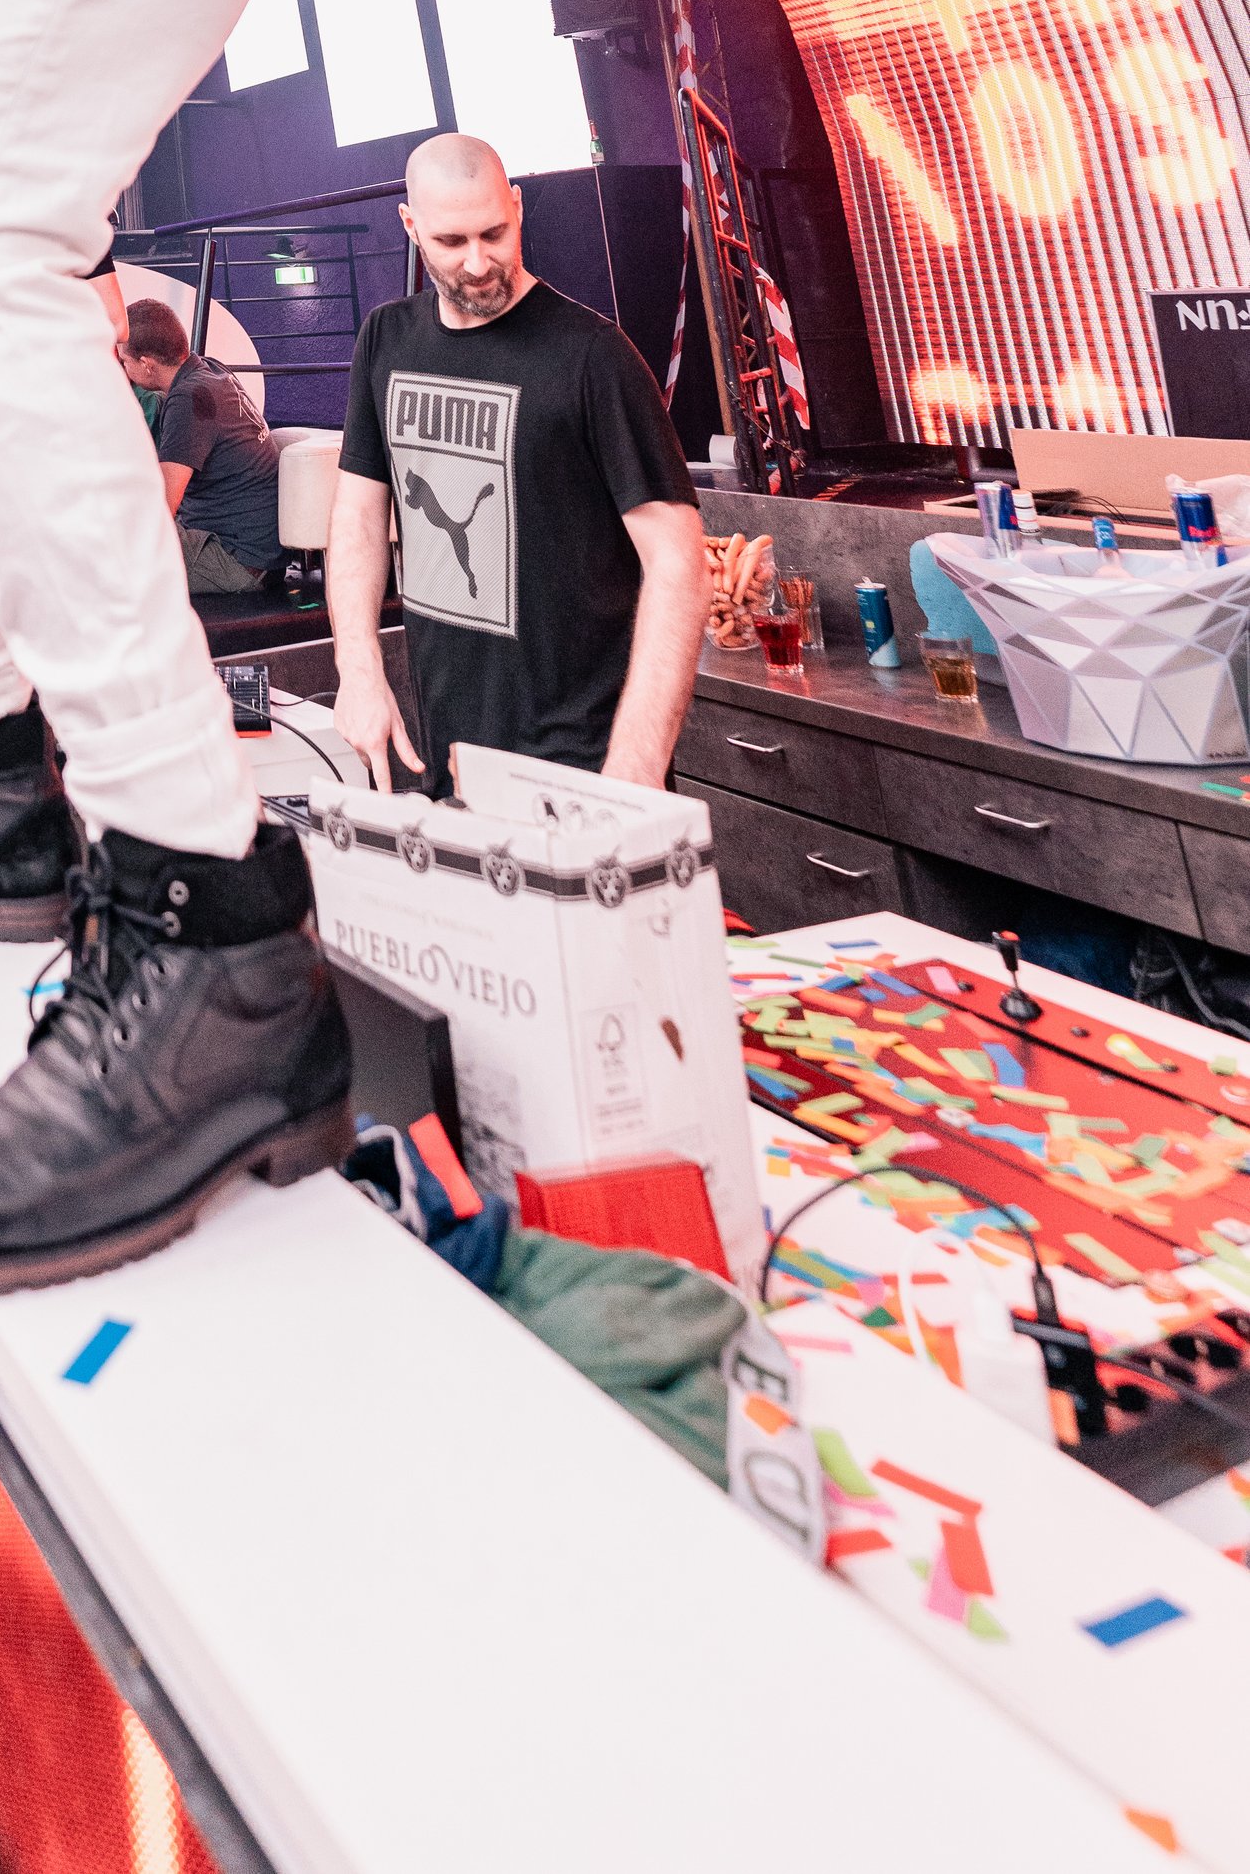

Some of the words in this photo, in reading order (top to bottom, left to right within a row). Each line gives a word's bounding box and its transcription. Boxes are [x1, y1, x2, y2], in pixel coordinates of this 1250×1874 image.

[396, 390, 500, 452] PUMA
[334, 918, 440, 986] PUEBLO
[430, 943, 538, 1017] VIEJO
